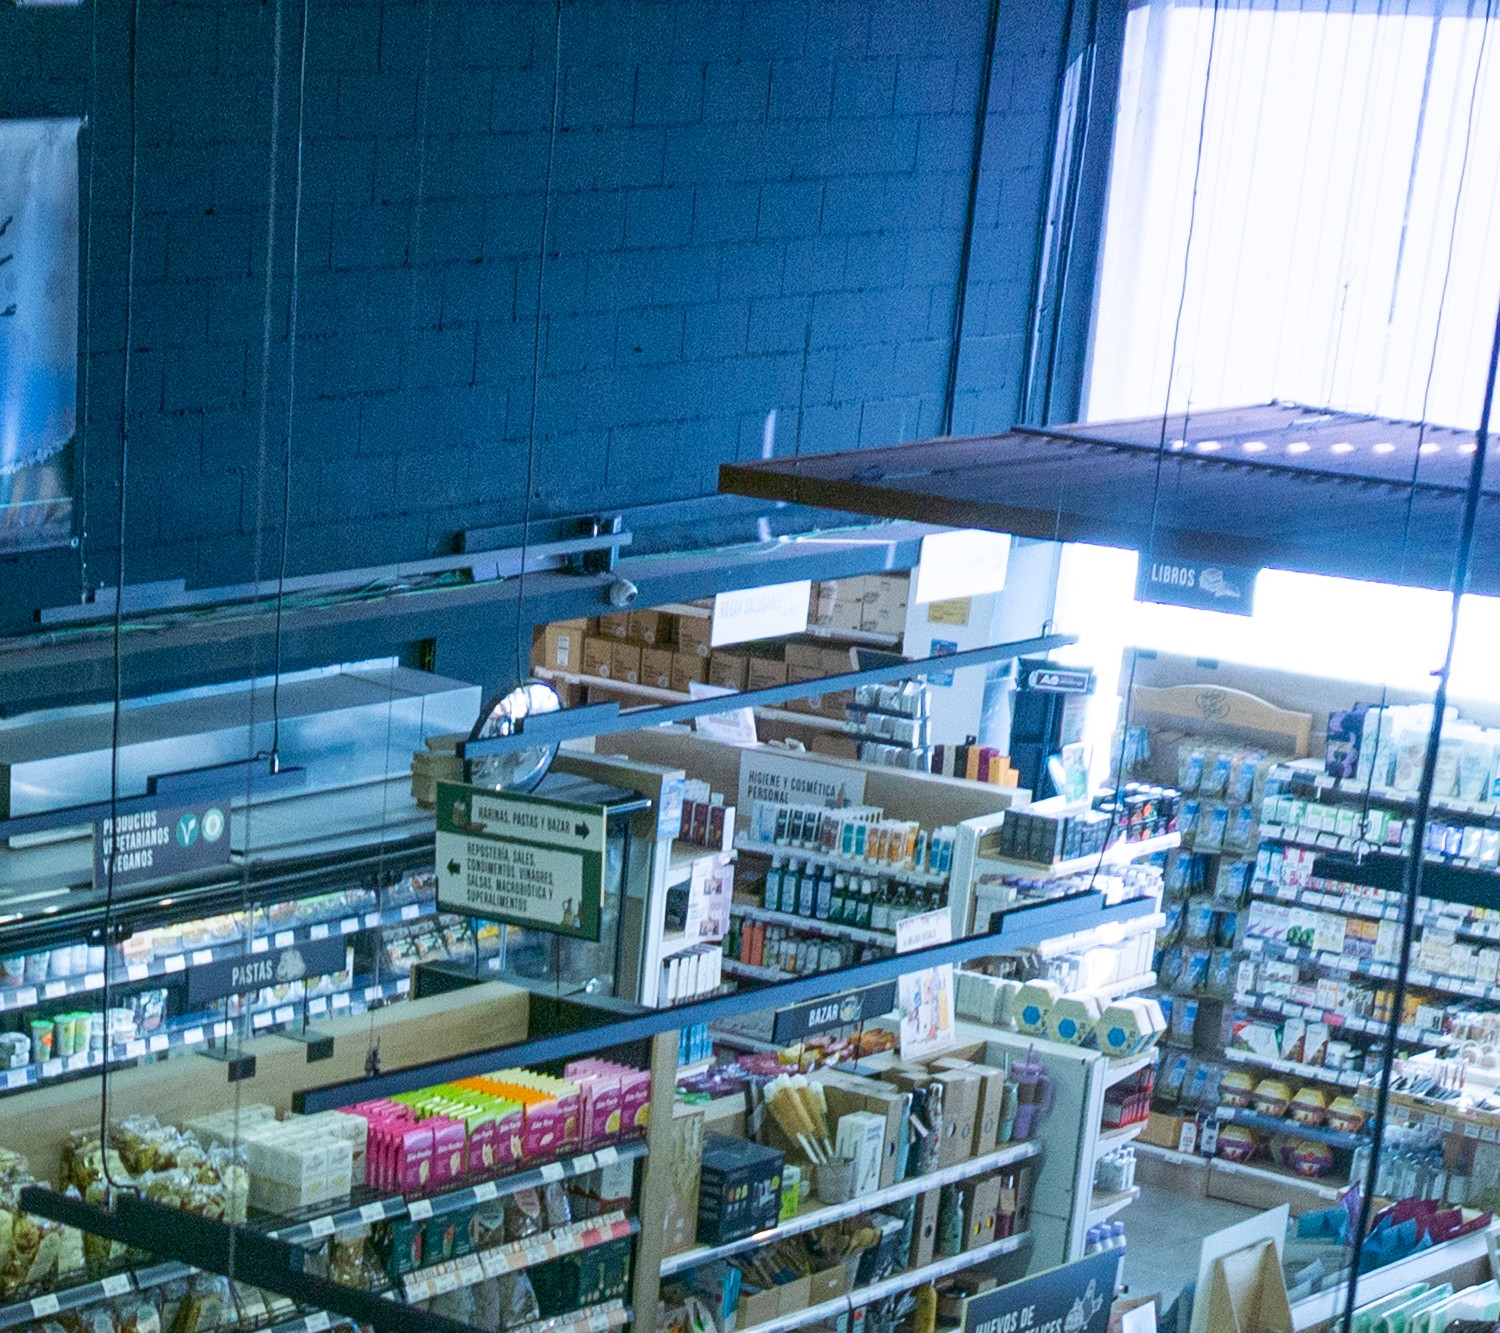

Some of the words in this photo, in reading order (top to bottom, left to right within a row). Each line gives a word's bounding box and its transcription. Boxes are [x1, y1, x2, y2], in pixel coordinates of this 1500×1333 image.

[1152, 564, 1195, 587] LIBROS
[747, 785, 788, 804] PERSONAL
[748, 771, 780, 787] HIGIENE
[783, 777, 788, 788] Y
[790, 777, 836, 798] COSMÉTICA
[512, 813, 538, 829] PASTAS
[547, 818, 570, 832] BAZAR
[231, 961, 272, 986] PASTAS
[808, 1004, 838, 1027] BAZAR
[1020, 1304, 1036, 1328] DE
